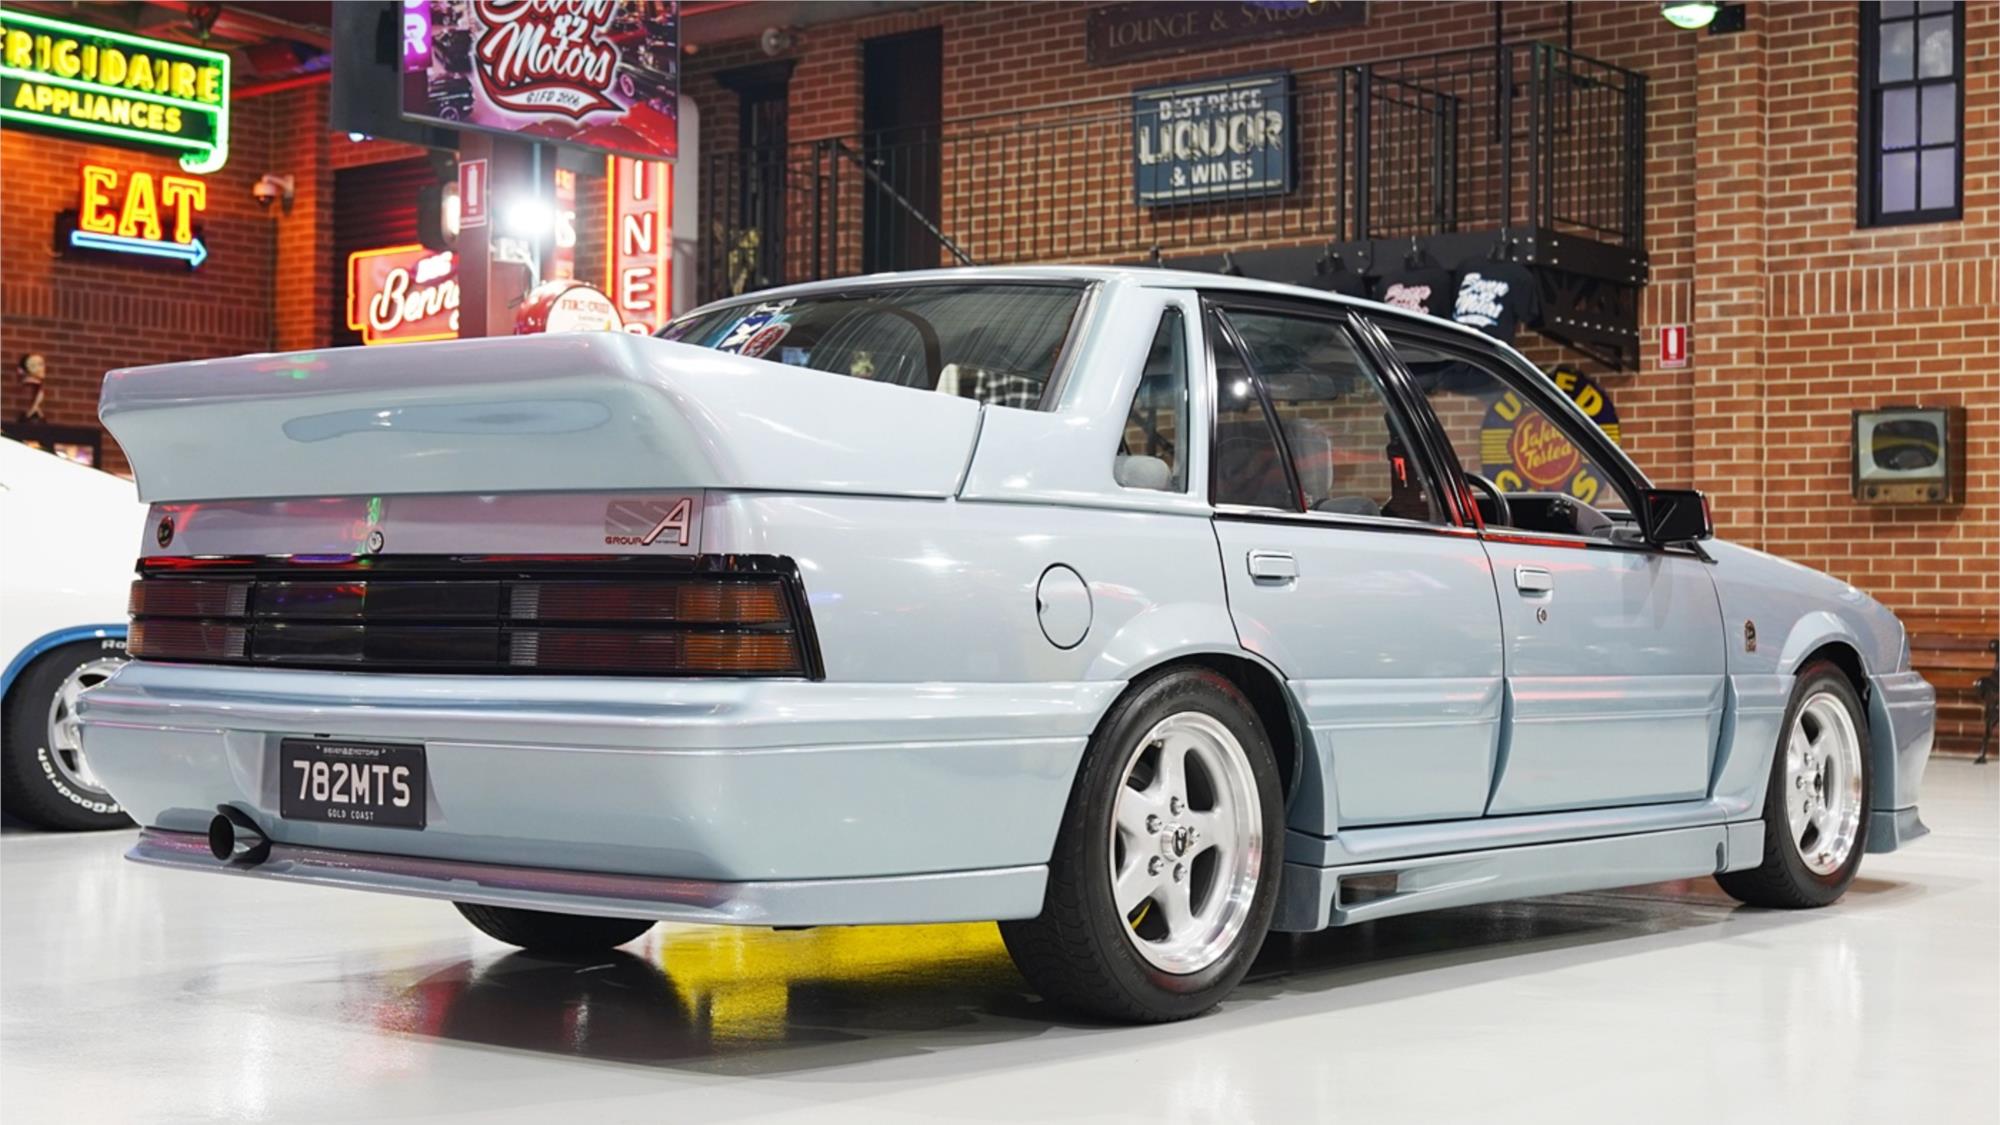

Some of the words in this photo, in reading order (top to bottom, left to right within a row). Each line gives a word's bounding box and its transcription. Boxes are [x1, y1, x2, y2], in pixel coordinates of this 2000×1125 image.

[551, 14, 587, 43] 82
[1108, 11, 1199, 48] LOUNGE
[1210, 9, 1229, 31] &
[484, 22, 611, 83] Motors
[15, 83, 182, 133] APPLIANCES
[1159, 96, 1204, 120] BEST
[1207, 89, 1263, 113] PRICE
[1139, 110, 1284, 165] LIQUOR
[1170, 166, 1186, 187] &
[1191, 159, 1253, 185] WINES
[81, 164, 206, 244] EAT
[1494, 371, 1603, 421] UED
[605, 536, 642, 545] GROUP
[641, 498, 692, 546] A
[293, 760, 411, 807] 782MTS
[327, 808, 347, 819] GOLD
[350, 810, 374, 821] COAST
